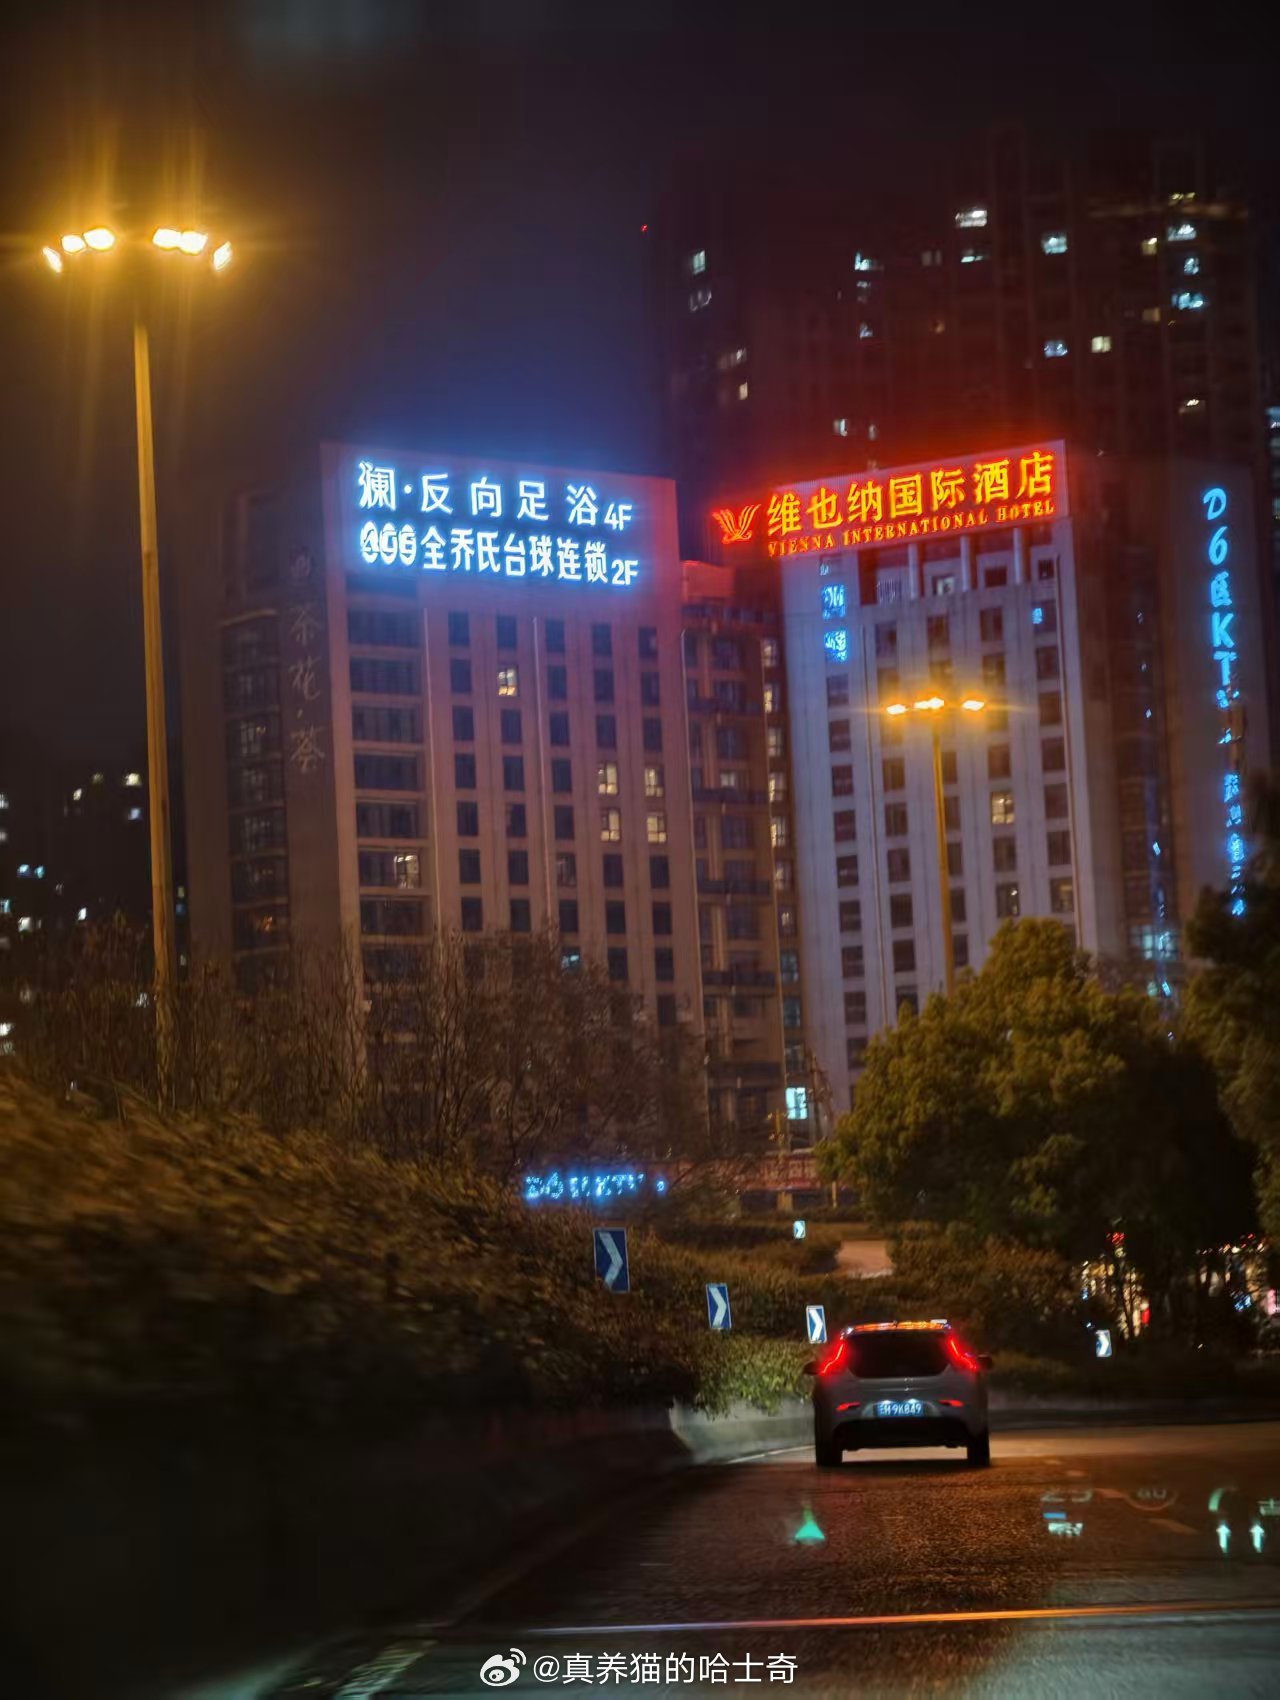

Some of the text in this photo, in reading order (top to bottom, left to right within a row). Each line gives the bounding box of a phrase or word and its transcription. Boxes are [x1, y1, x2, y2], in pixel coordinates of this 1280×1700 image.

[767, 451, 1054, 536] 维也纳国际酒店
[768, 499, 1056, 557] VIENNA INTERNATIONAL HOTEL
